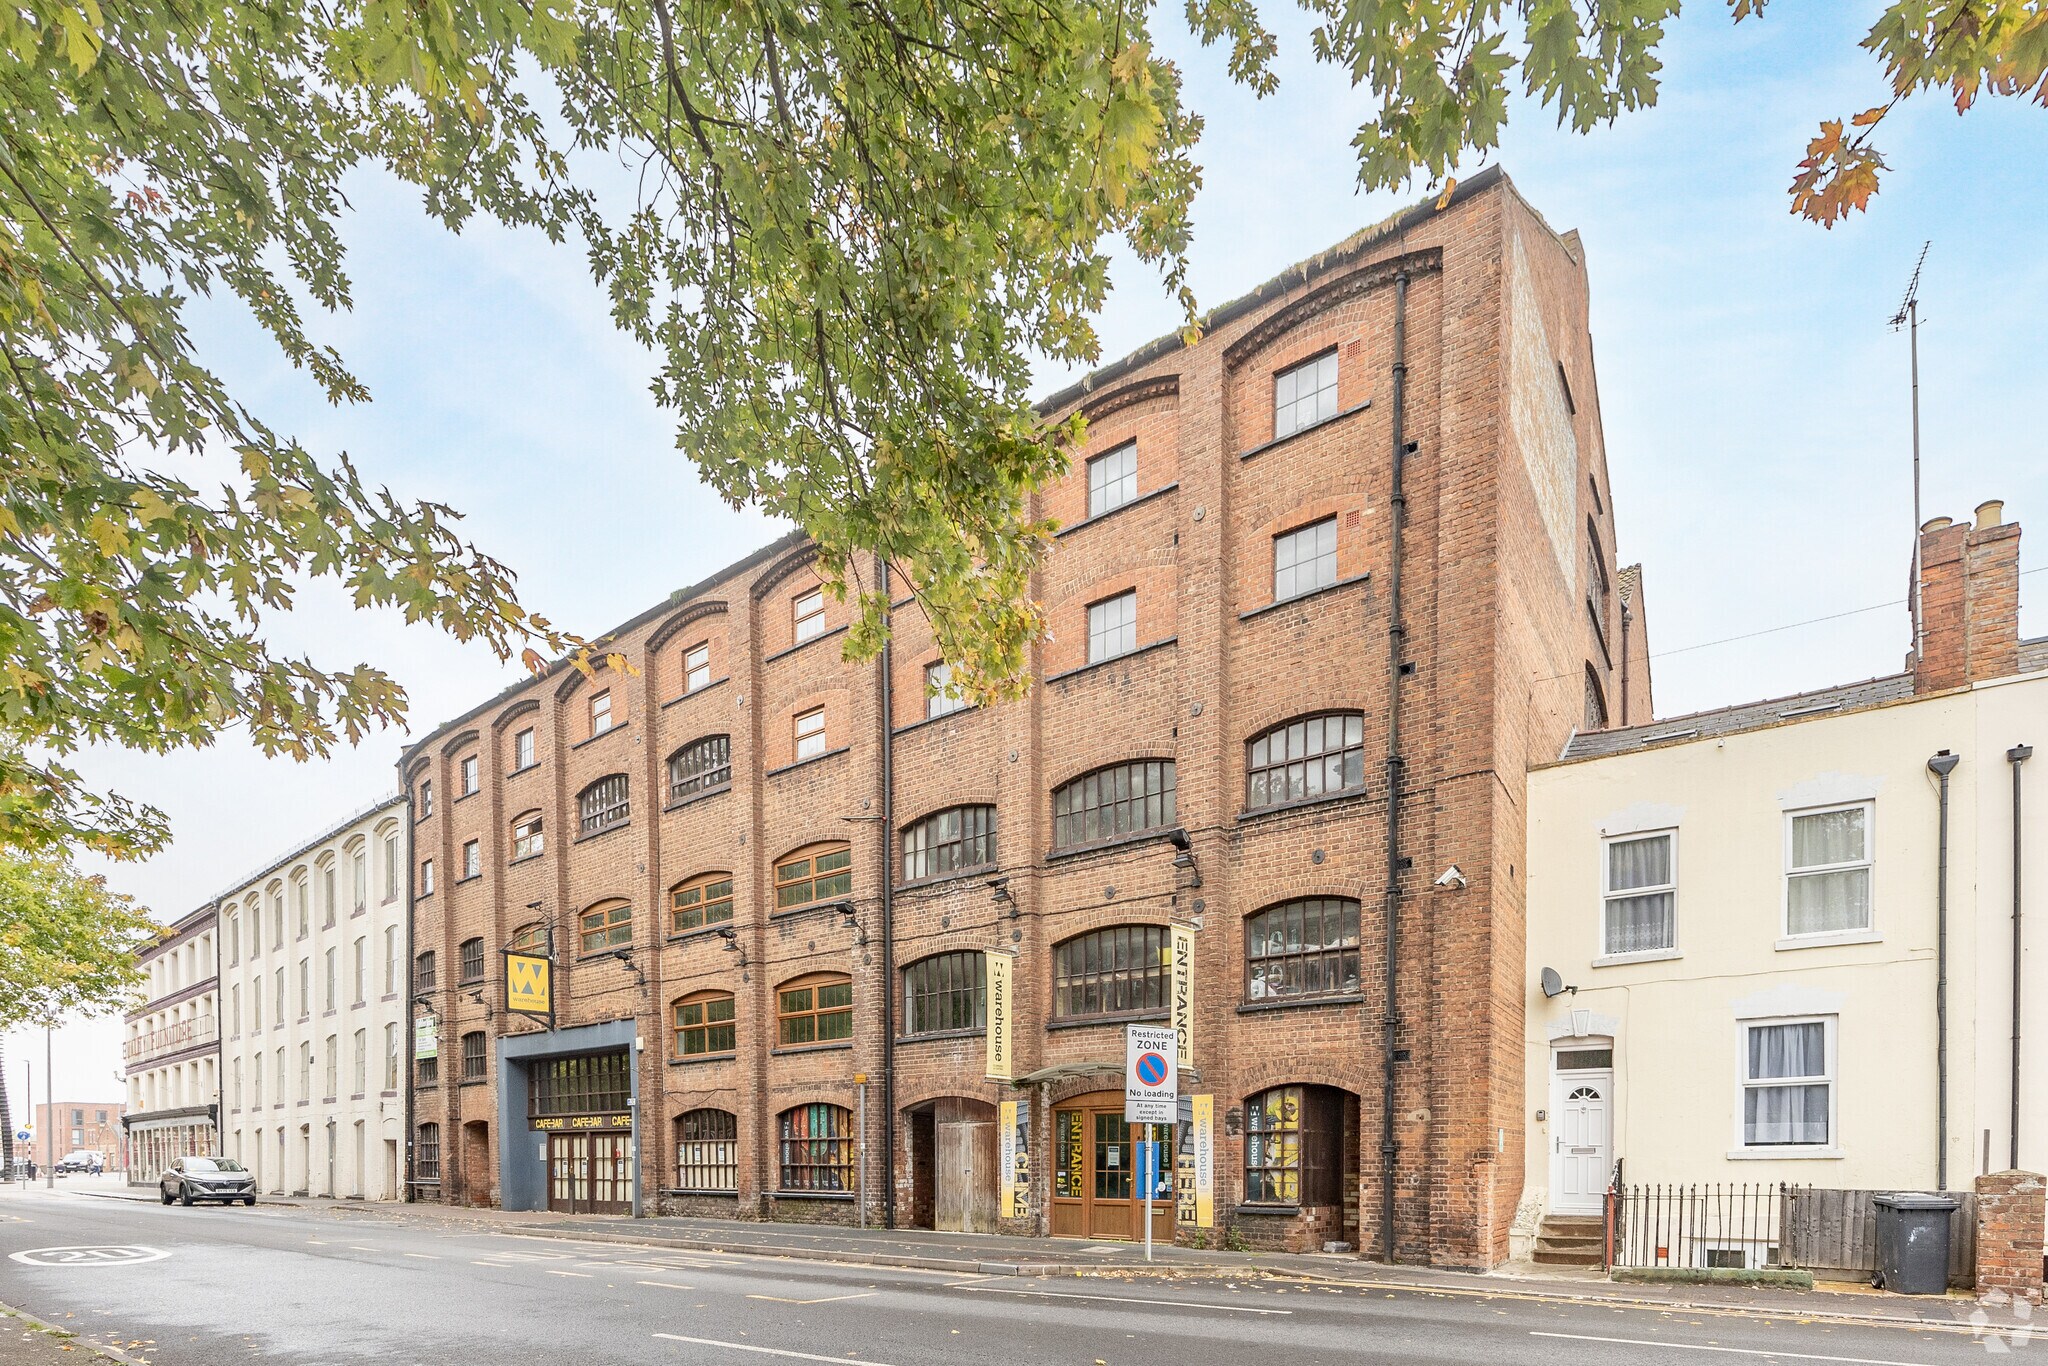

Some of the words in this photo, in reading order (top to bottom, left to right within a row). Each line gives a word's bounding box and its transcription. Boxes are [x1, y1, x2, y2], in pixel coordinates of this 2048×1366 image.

[995, 980, 1005, 1062] warehouse
[1177, 936, 1188, 1060] ENTRANCE
[1131, 1030, 1174, 1040] Restricted
[1136, 1040, 1168, 1050] ZONE
[1129, 1089, 1142, 1097] No
[1144, 1089, 1175, 1099] loading
[1005, 1122, 1013, 1182] warehouse
[1071, 1112, 1083, 1197] ENTRANCE
[1200, 1118, 1209, 1186] warehouse
[1251, 1117, 1260, 1170] waehous
[1015, 1152, 1029, 1218] CLIMB
[42, 1249, 143, 1262] 20
